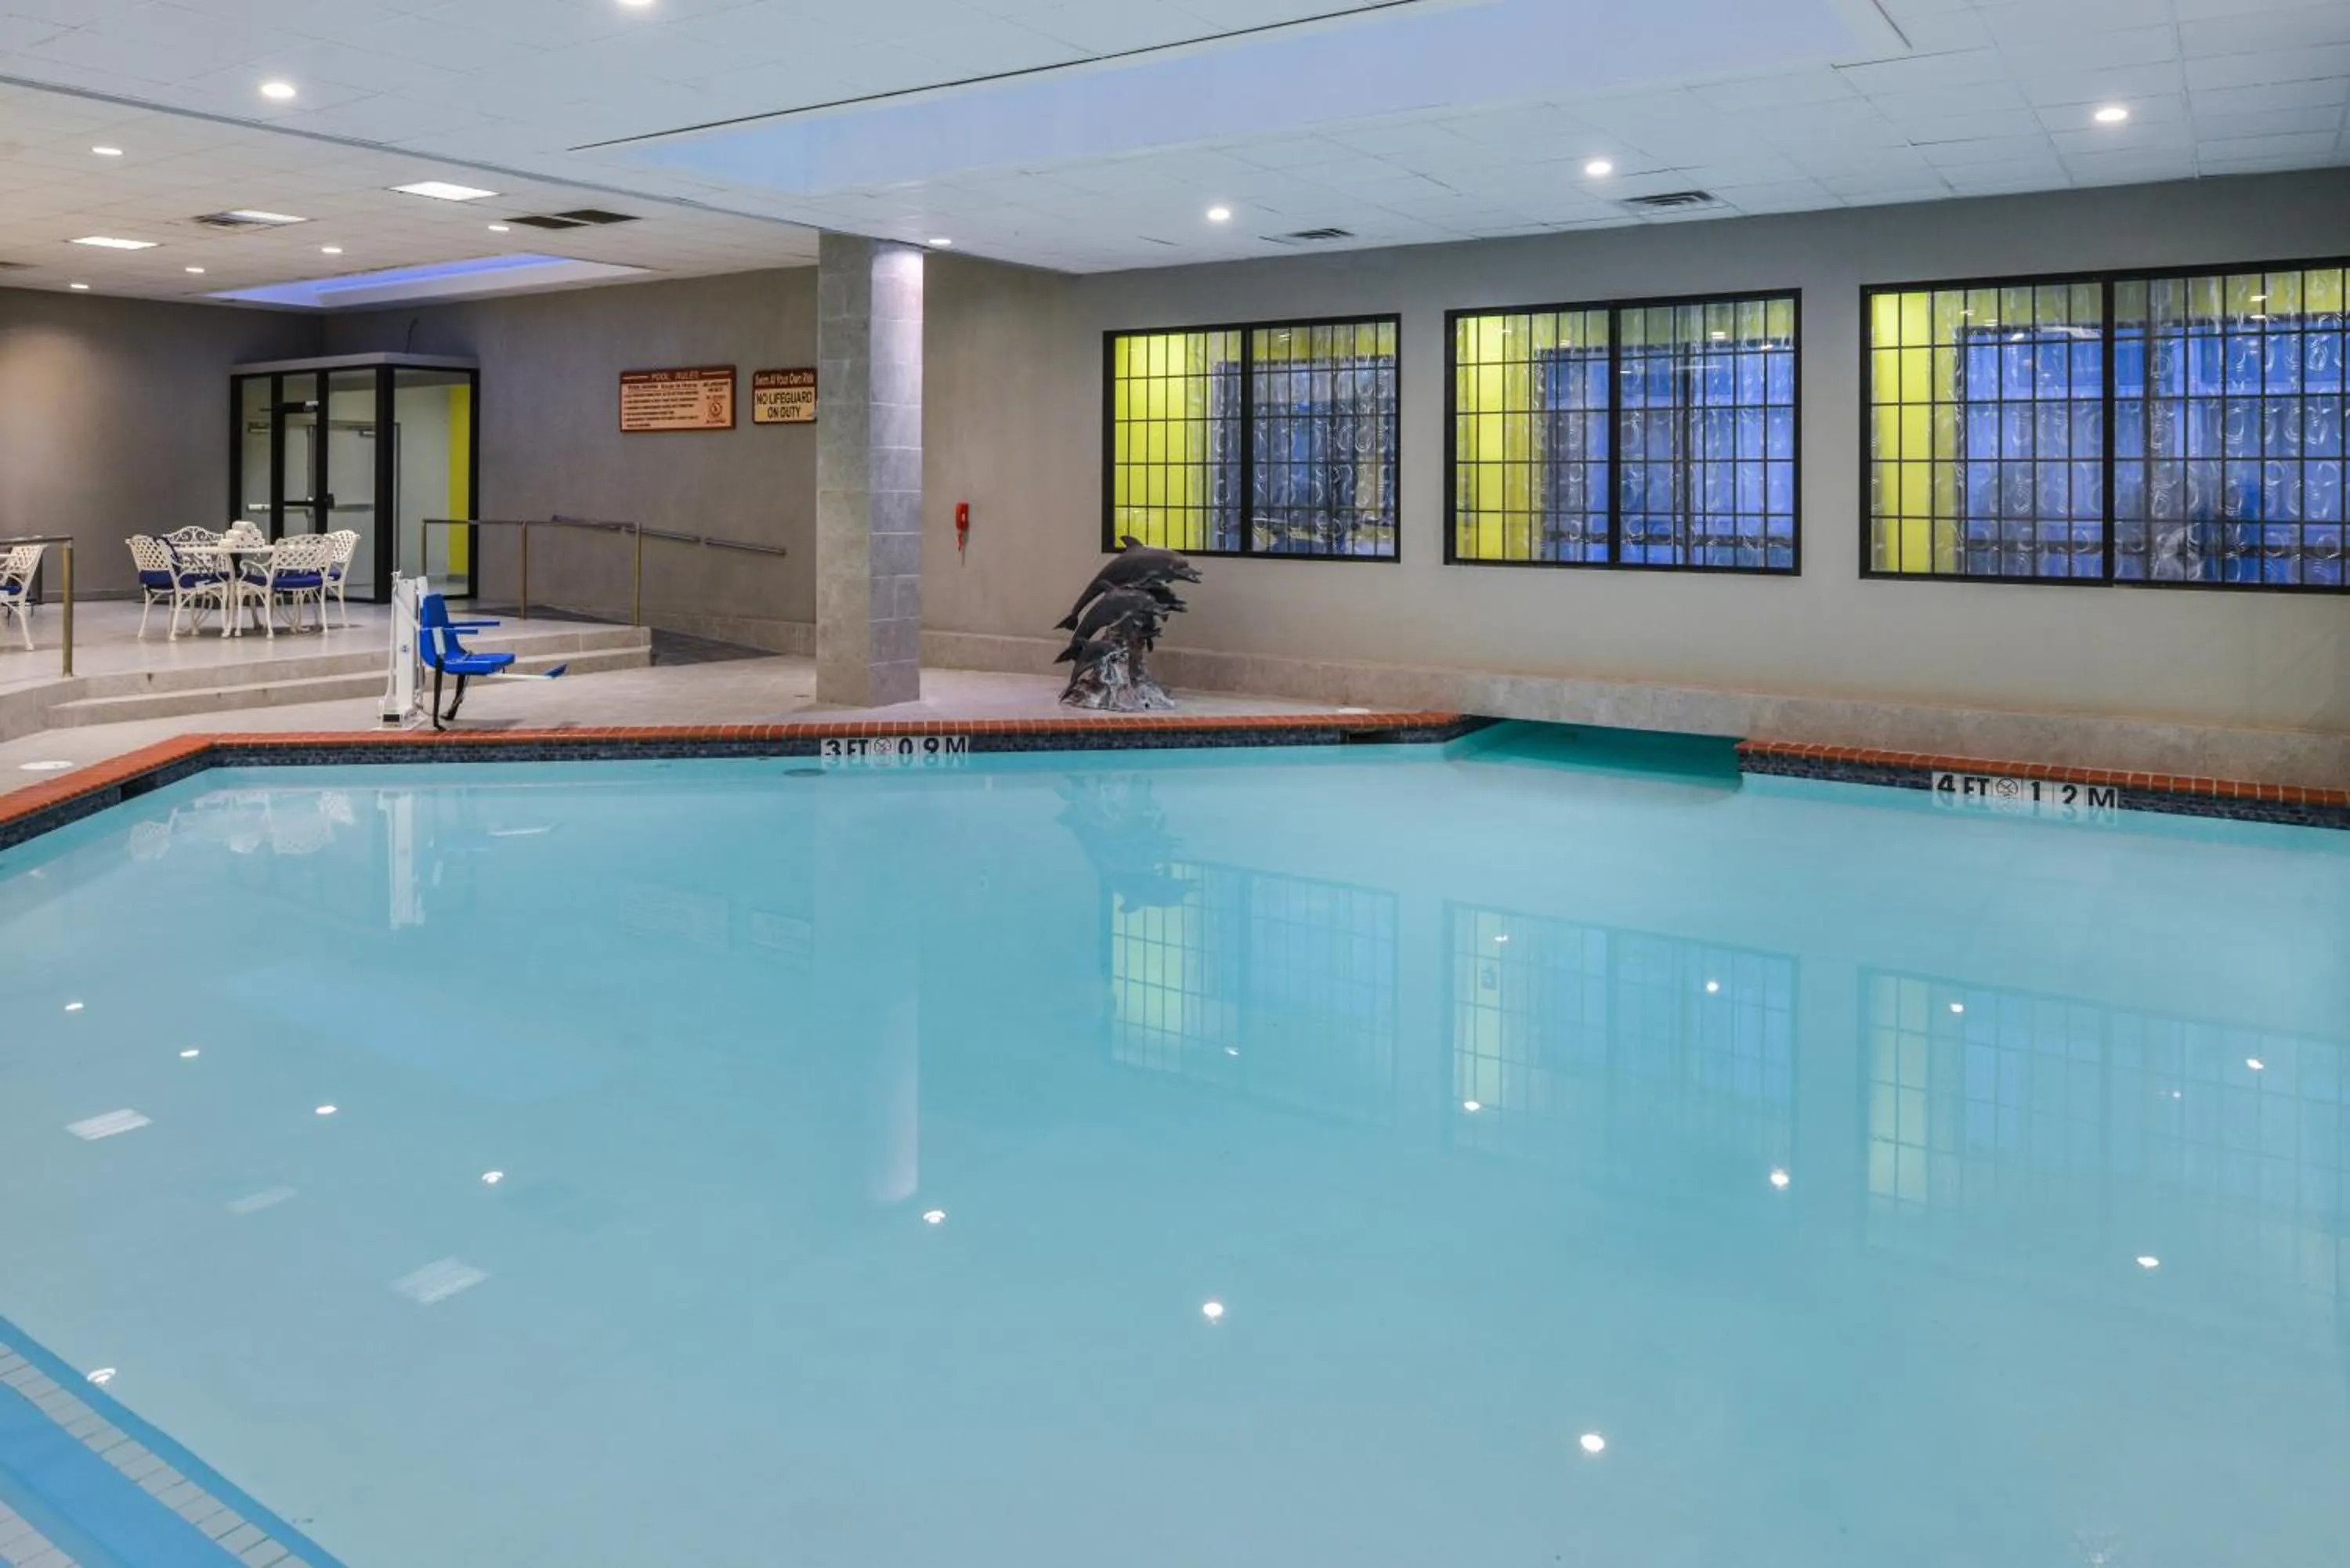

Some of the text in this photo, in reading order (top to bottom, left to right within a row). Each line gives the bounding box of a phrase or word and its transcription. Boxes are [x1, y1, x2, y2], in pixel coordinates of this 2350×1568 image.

[757, 390, 812, 405] NO LIFEGUARD
[767, 406, 801, 418] ON DUTY
